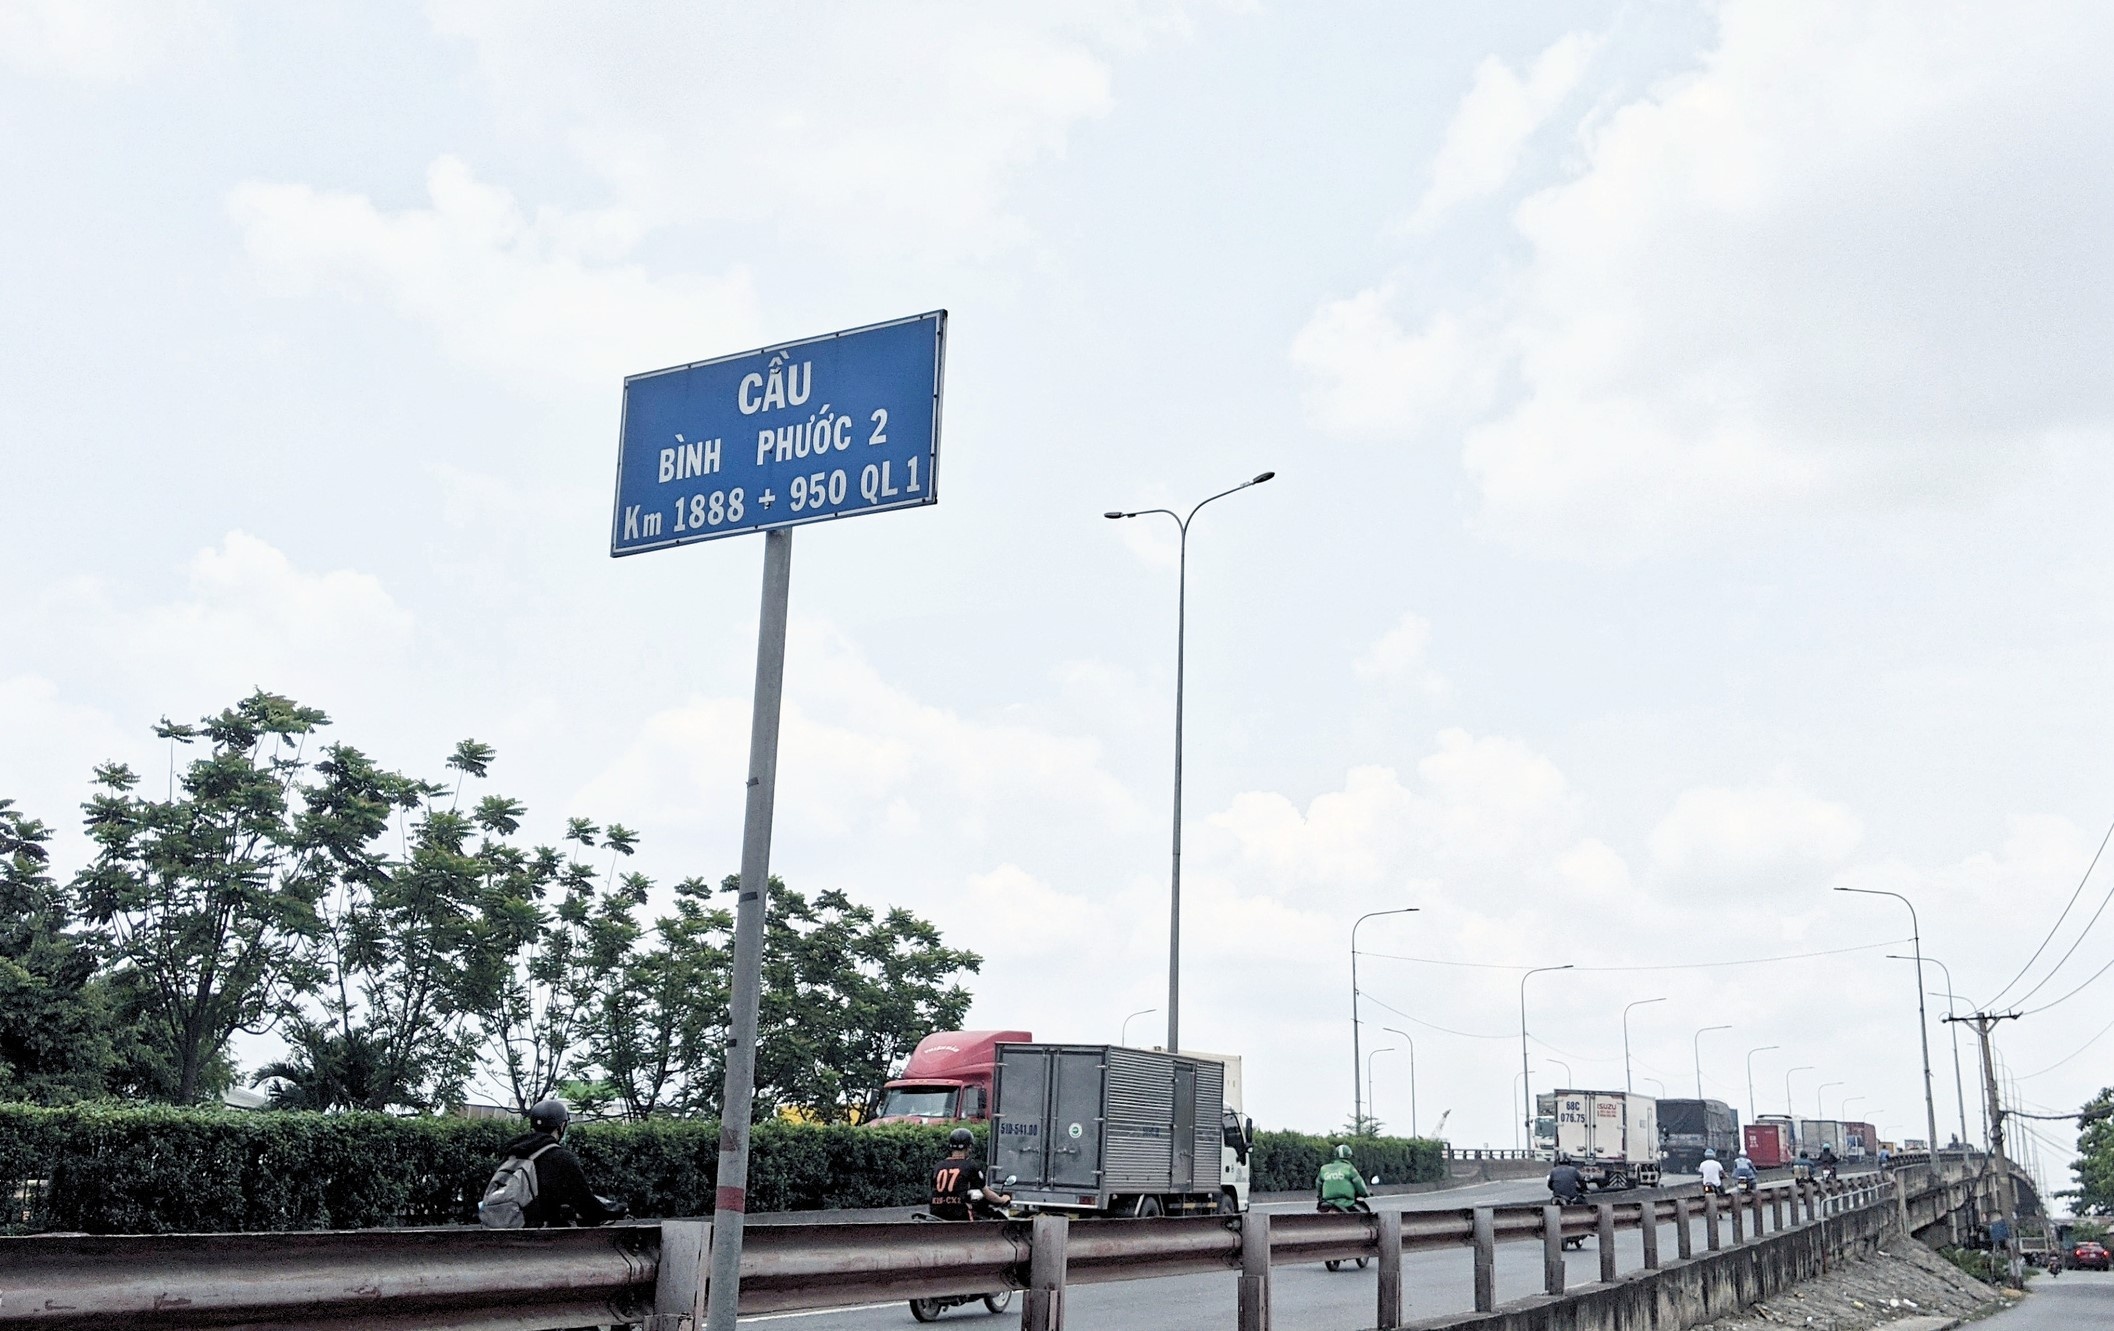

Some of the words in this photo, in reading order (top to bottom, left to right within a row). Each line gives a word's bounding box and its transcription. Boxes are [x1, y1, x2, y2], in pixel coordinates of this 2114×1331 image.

[738, 350, 812, 415] CẦU
[658, 434, 722, 483] BÌNH
[756, 404, 852, 466] PHƯỚC
[868, 408, 888, 446] 2
[623, 504, 662, 540] Km
[673, 487, 745, 532] 1888
[758, 489, 776, 511] +
[790, 469, 847, 512] 950
[860, 460, 898, 504] QL
[906, 456, 921, 493] 1
[1566, 1101, 1580, 1111] 68C
[936, 1168, 960, 1192] 07
[1324, 1170, 1345, 1180] Grab
